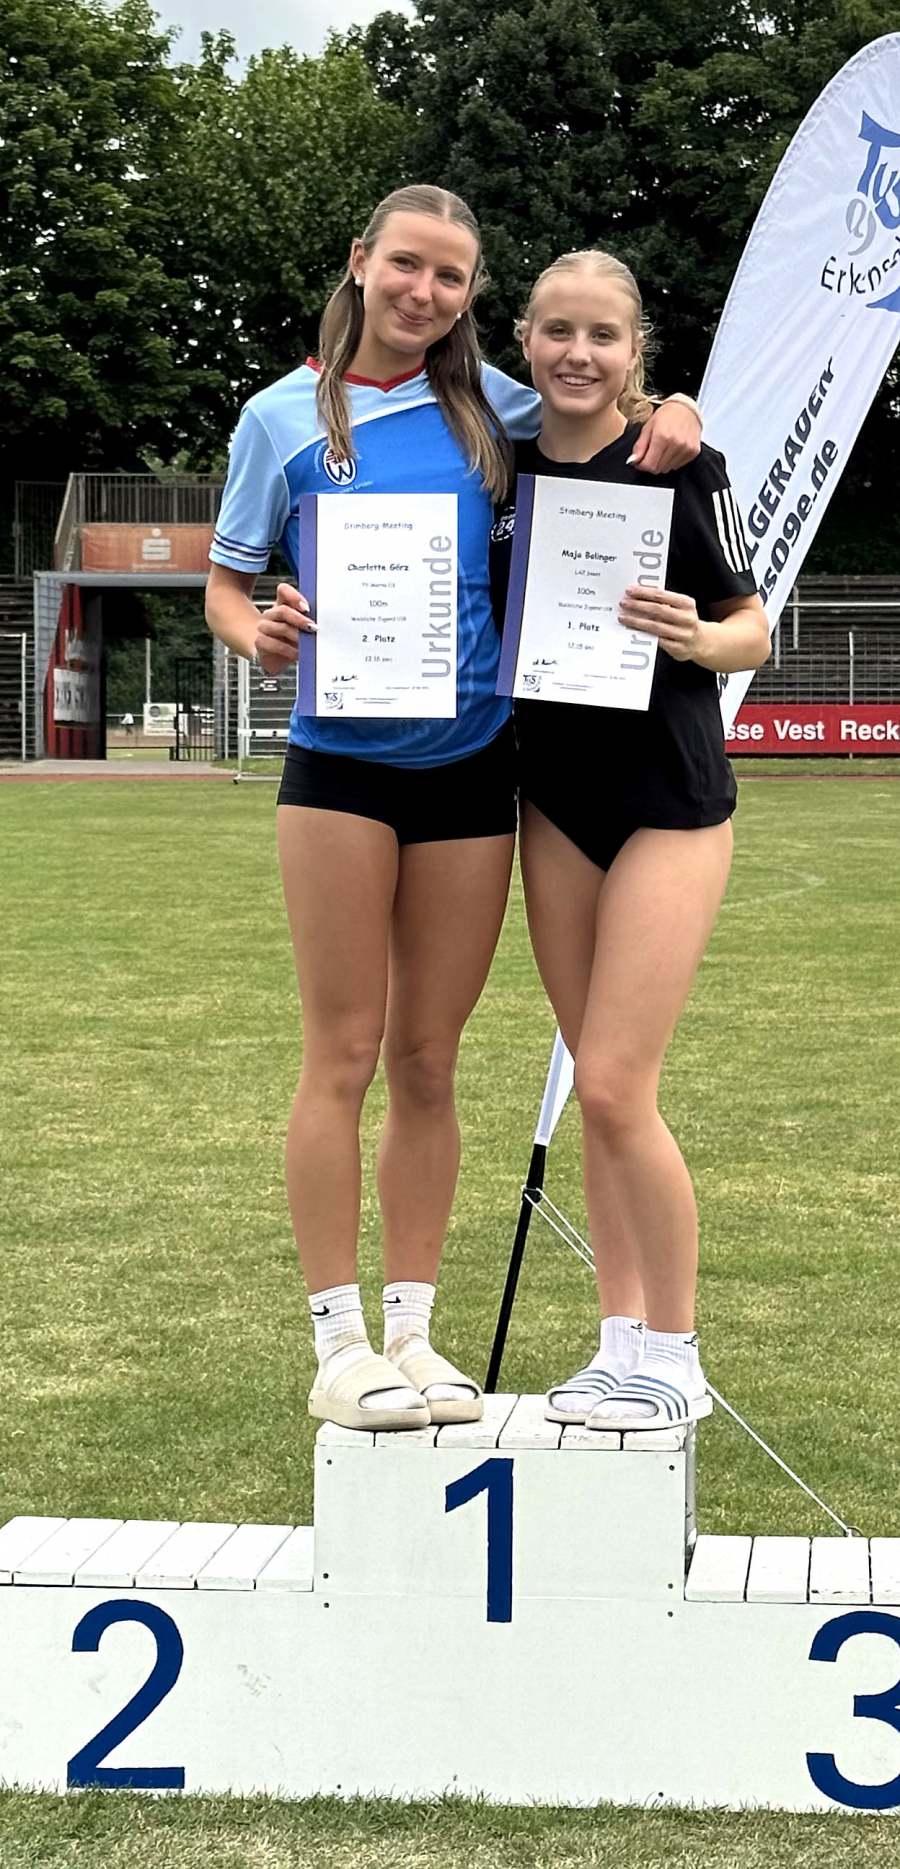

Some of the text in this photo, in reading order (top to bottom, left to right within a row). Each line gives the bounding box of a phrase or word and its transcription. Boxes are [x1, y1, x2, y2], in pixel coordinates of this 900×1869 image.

[559, 507, 627, 522] Stimberg Meeting
[382, 523, 413, 531] Meeting
[561, 549, 582, 560] Maja
[347, 563, 386, 571] Charlotte
[577, 587, 596, 595] 100m
[421, 535, 452, 678] Urkunde
[620, 529, 664, 670] Urnde
[567, 620, 600, 632] 1. Platz
[374, 634, 396, 643] Platz
[773, 719, 825, 741] Vest
[840, 719, 900, 741] Reck
[445, 1457, 514, 1623] 1
[66, 1599, 186, 1790] 2
[805, 1610, 900, 1810] 3
